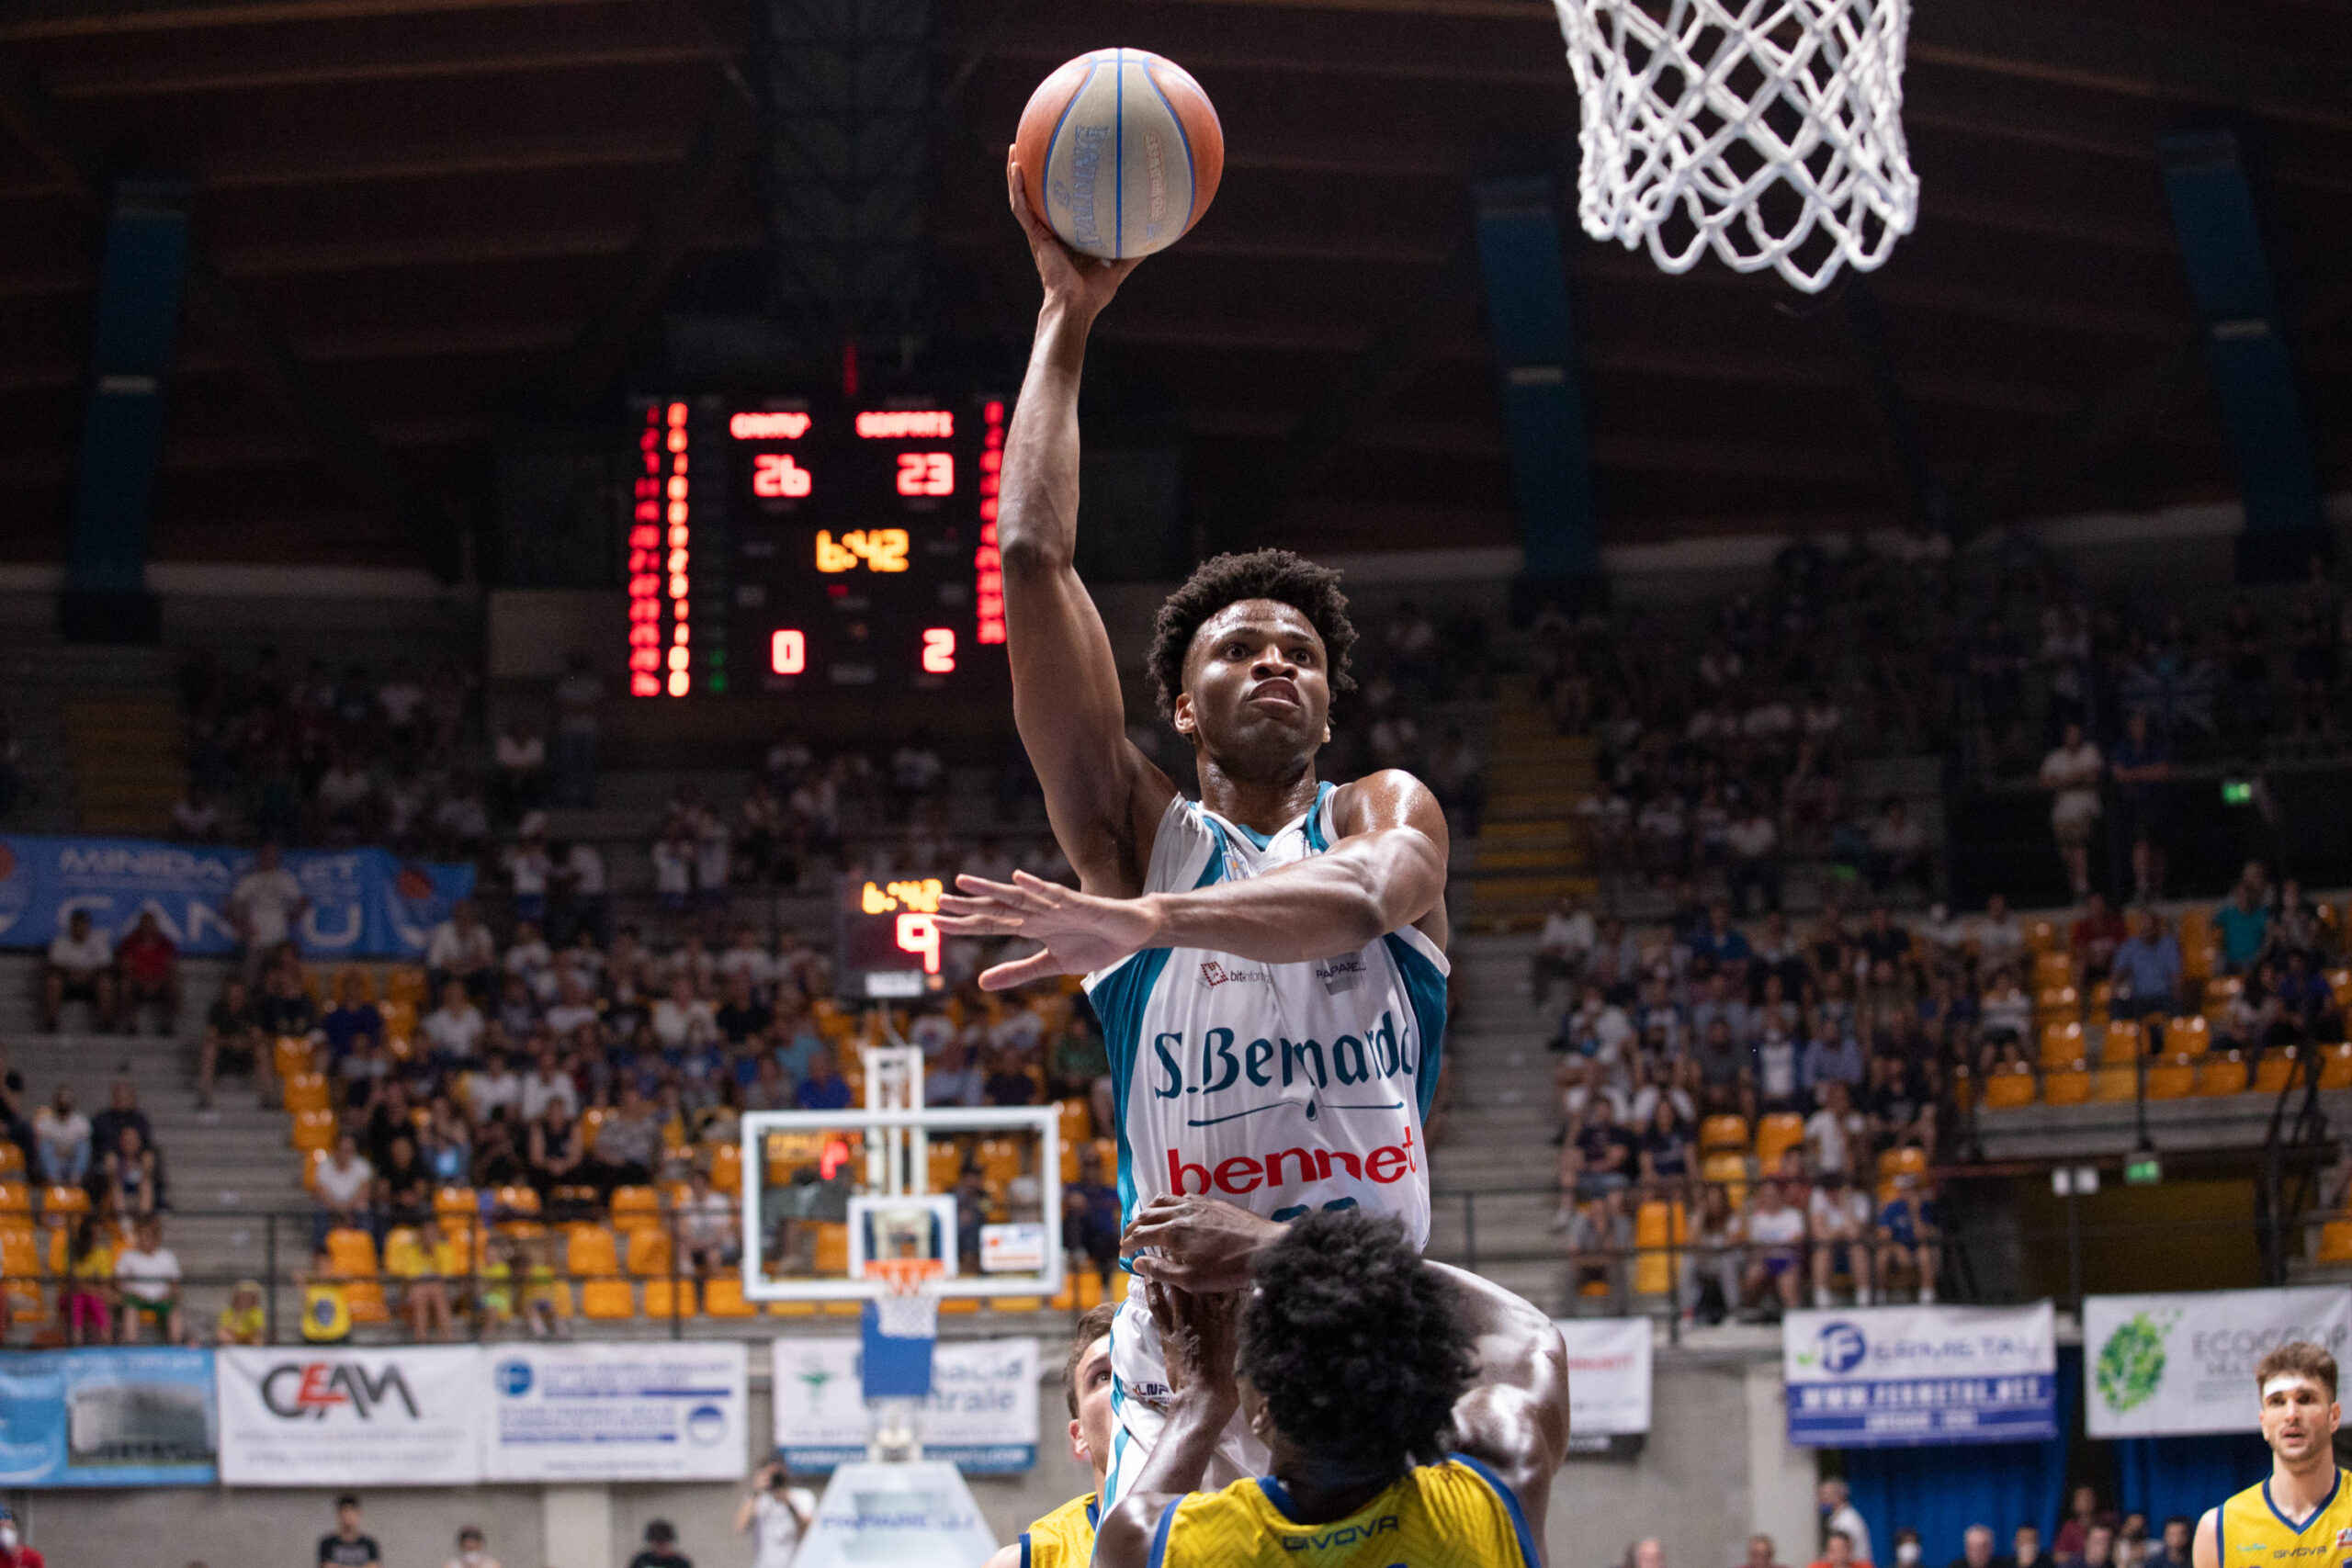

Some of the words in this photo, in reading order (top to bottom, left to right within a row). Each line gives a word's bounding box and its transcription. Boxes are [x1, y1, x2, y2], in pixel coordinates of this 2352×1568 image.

[1073, 126, 1108, 253] PALDING
[753, 454, 812, 498] 26
[897, 452, 955, 496] 23
[816, 528, 910, 573] 6:42
[772, 629, 805, 674] 0
[922, 627, 956, 672] 2
[897, 912, 941, 975] 9
[1168, 1126, 1417, 1197] bennet
[260, 1361, 422, 1420] CEAM
[1283, 1516, 1400, 1551] GIVOVA
